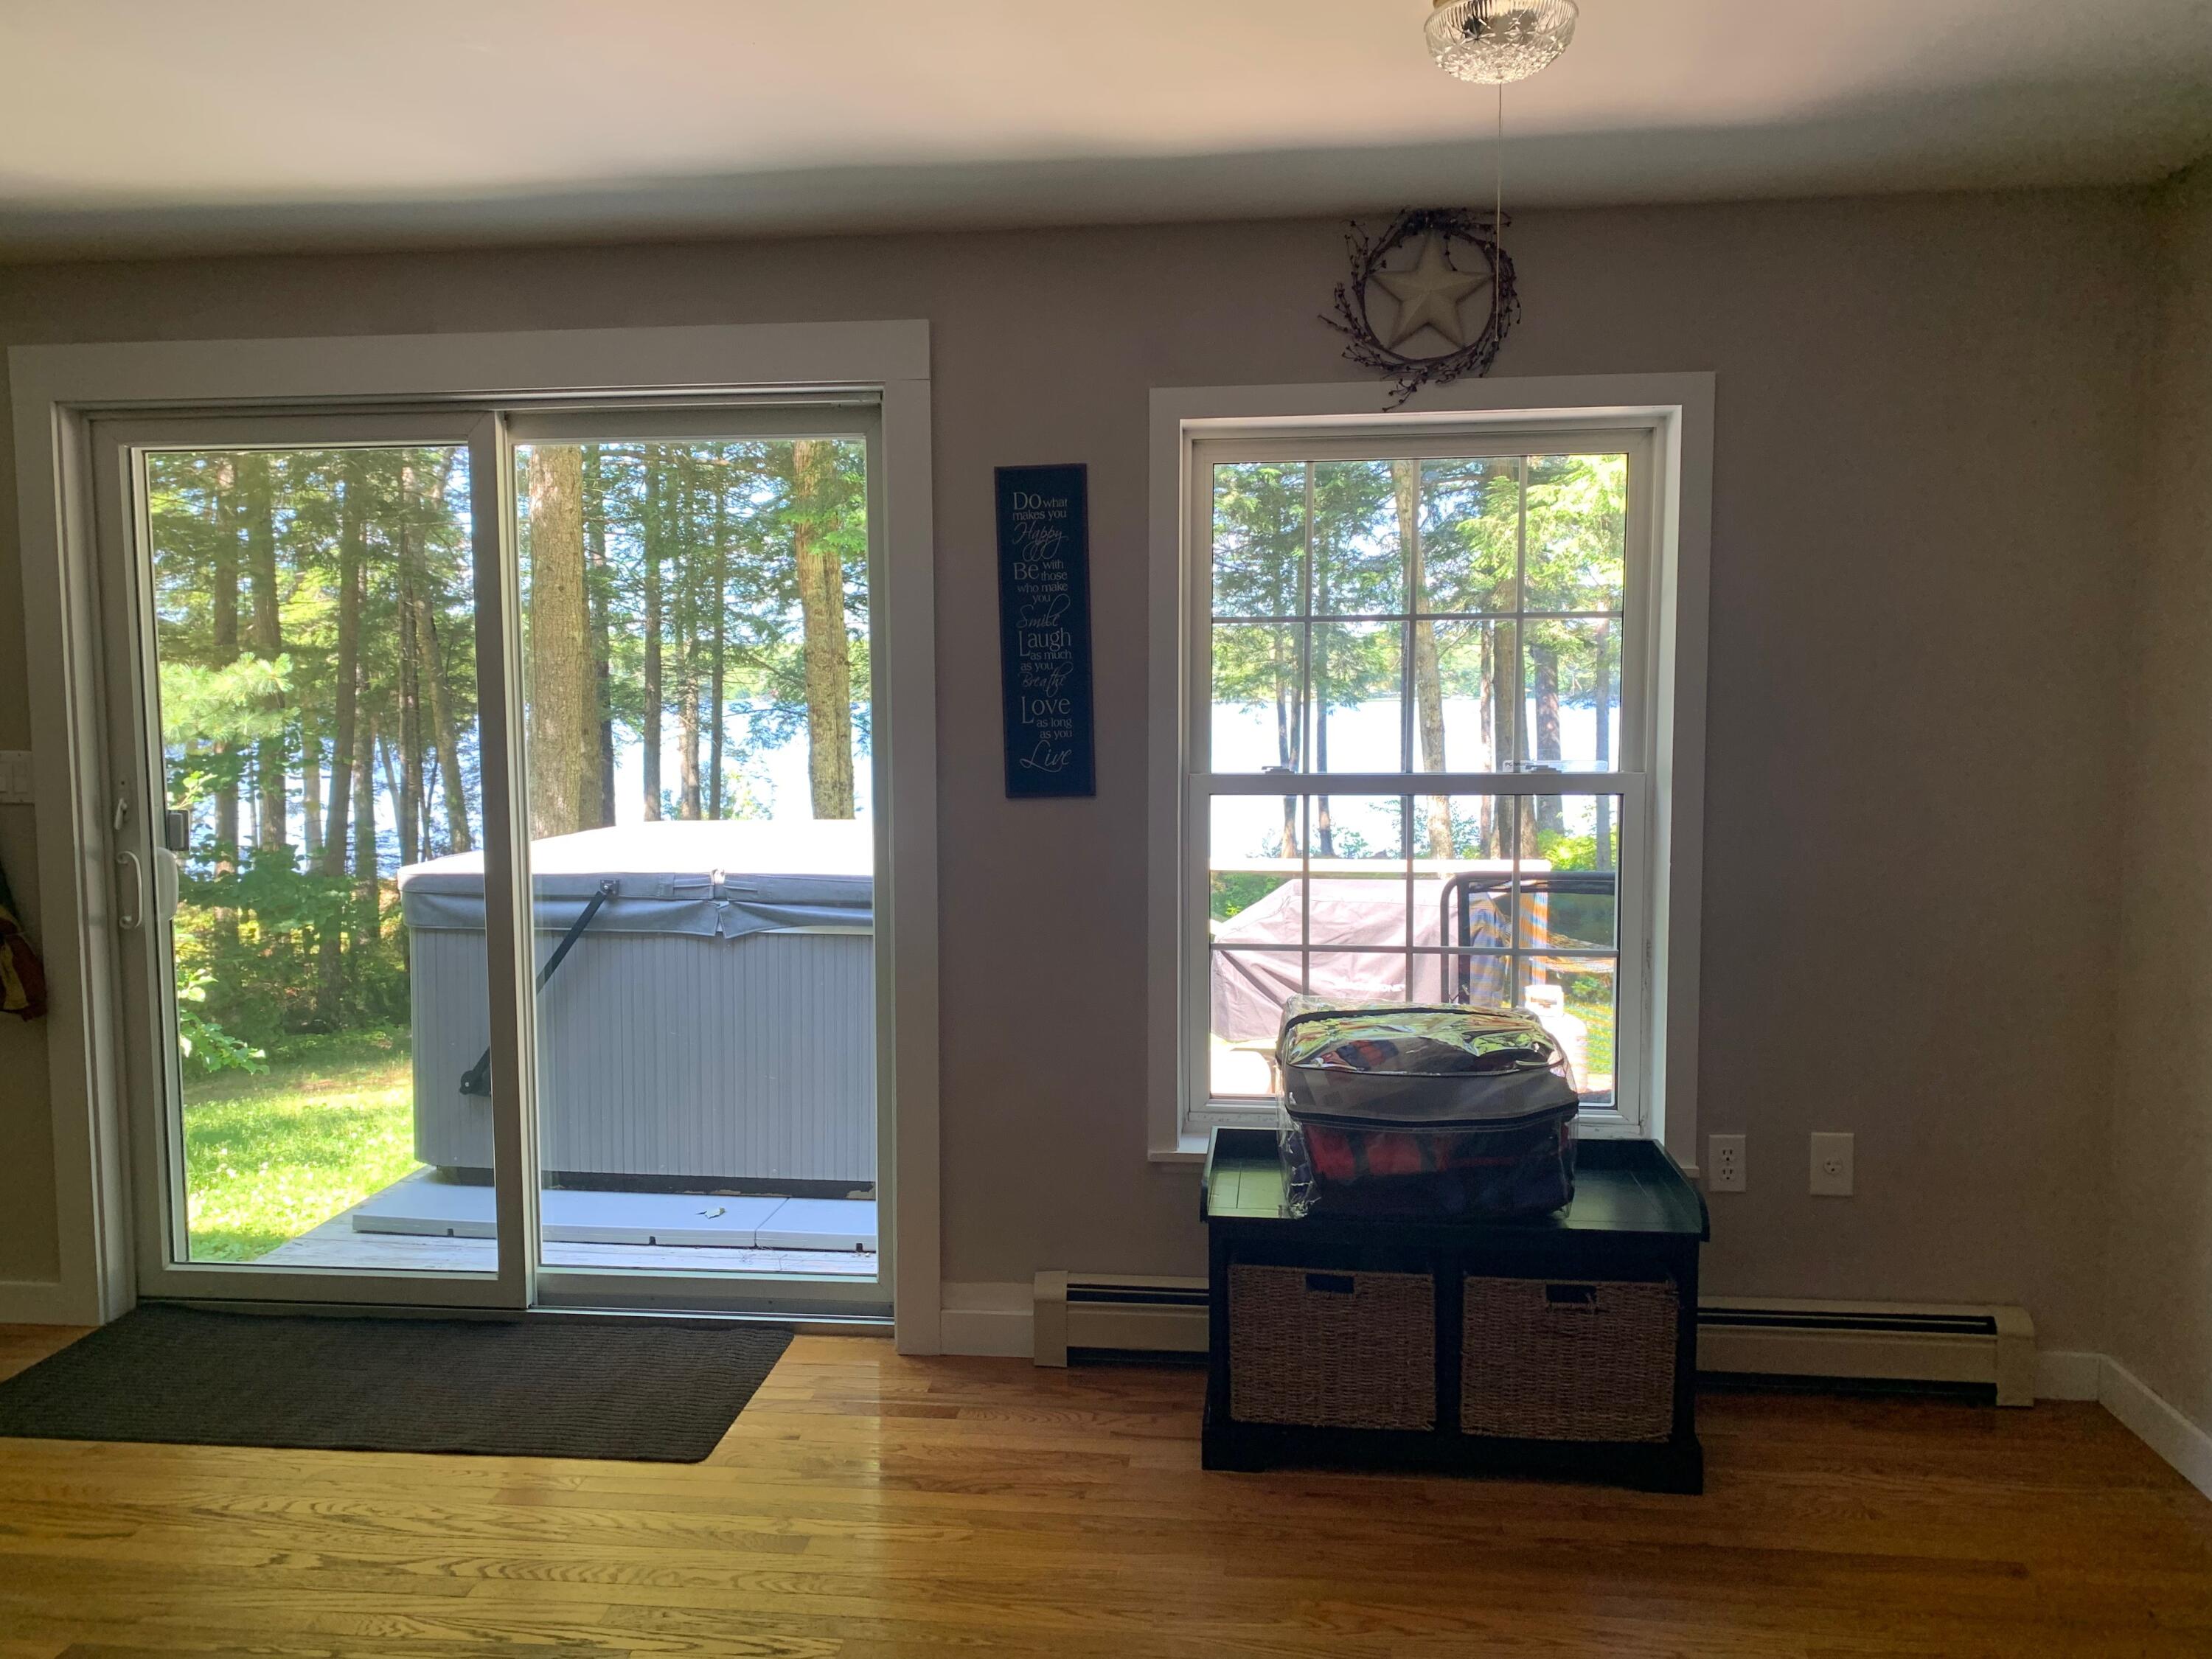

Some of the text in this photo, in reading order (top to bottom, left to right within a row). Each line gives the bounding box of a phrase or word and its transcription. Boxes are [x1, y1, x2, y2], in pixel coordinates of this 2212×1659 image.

[1043, 497, 1068, 508] what
[1012, 509, 1067, 521] makes you
[1012, 520, 1069, 562] Happy
[1013, 560, 1064, 580] Be with
[1041, 571, 1068, 581] those
[1018, 582, 1068, 593] who make
[1032, 594, 1051, 605] you
[1016, 594, 1071, 628] Smile
[1018, 627, 1071, 656] Laugh
[1030, 649, 1072, 661] as much
[1020, 662, 1053, 672] as you
[1021, 696, 1071, 724] Love
[1036, 717, 1073, 728] as long
[1039, 730, 1073, 740] as you
[1019, 740, 1072, 772] Live
